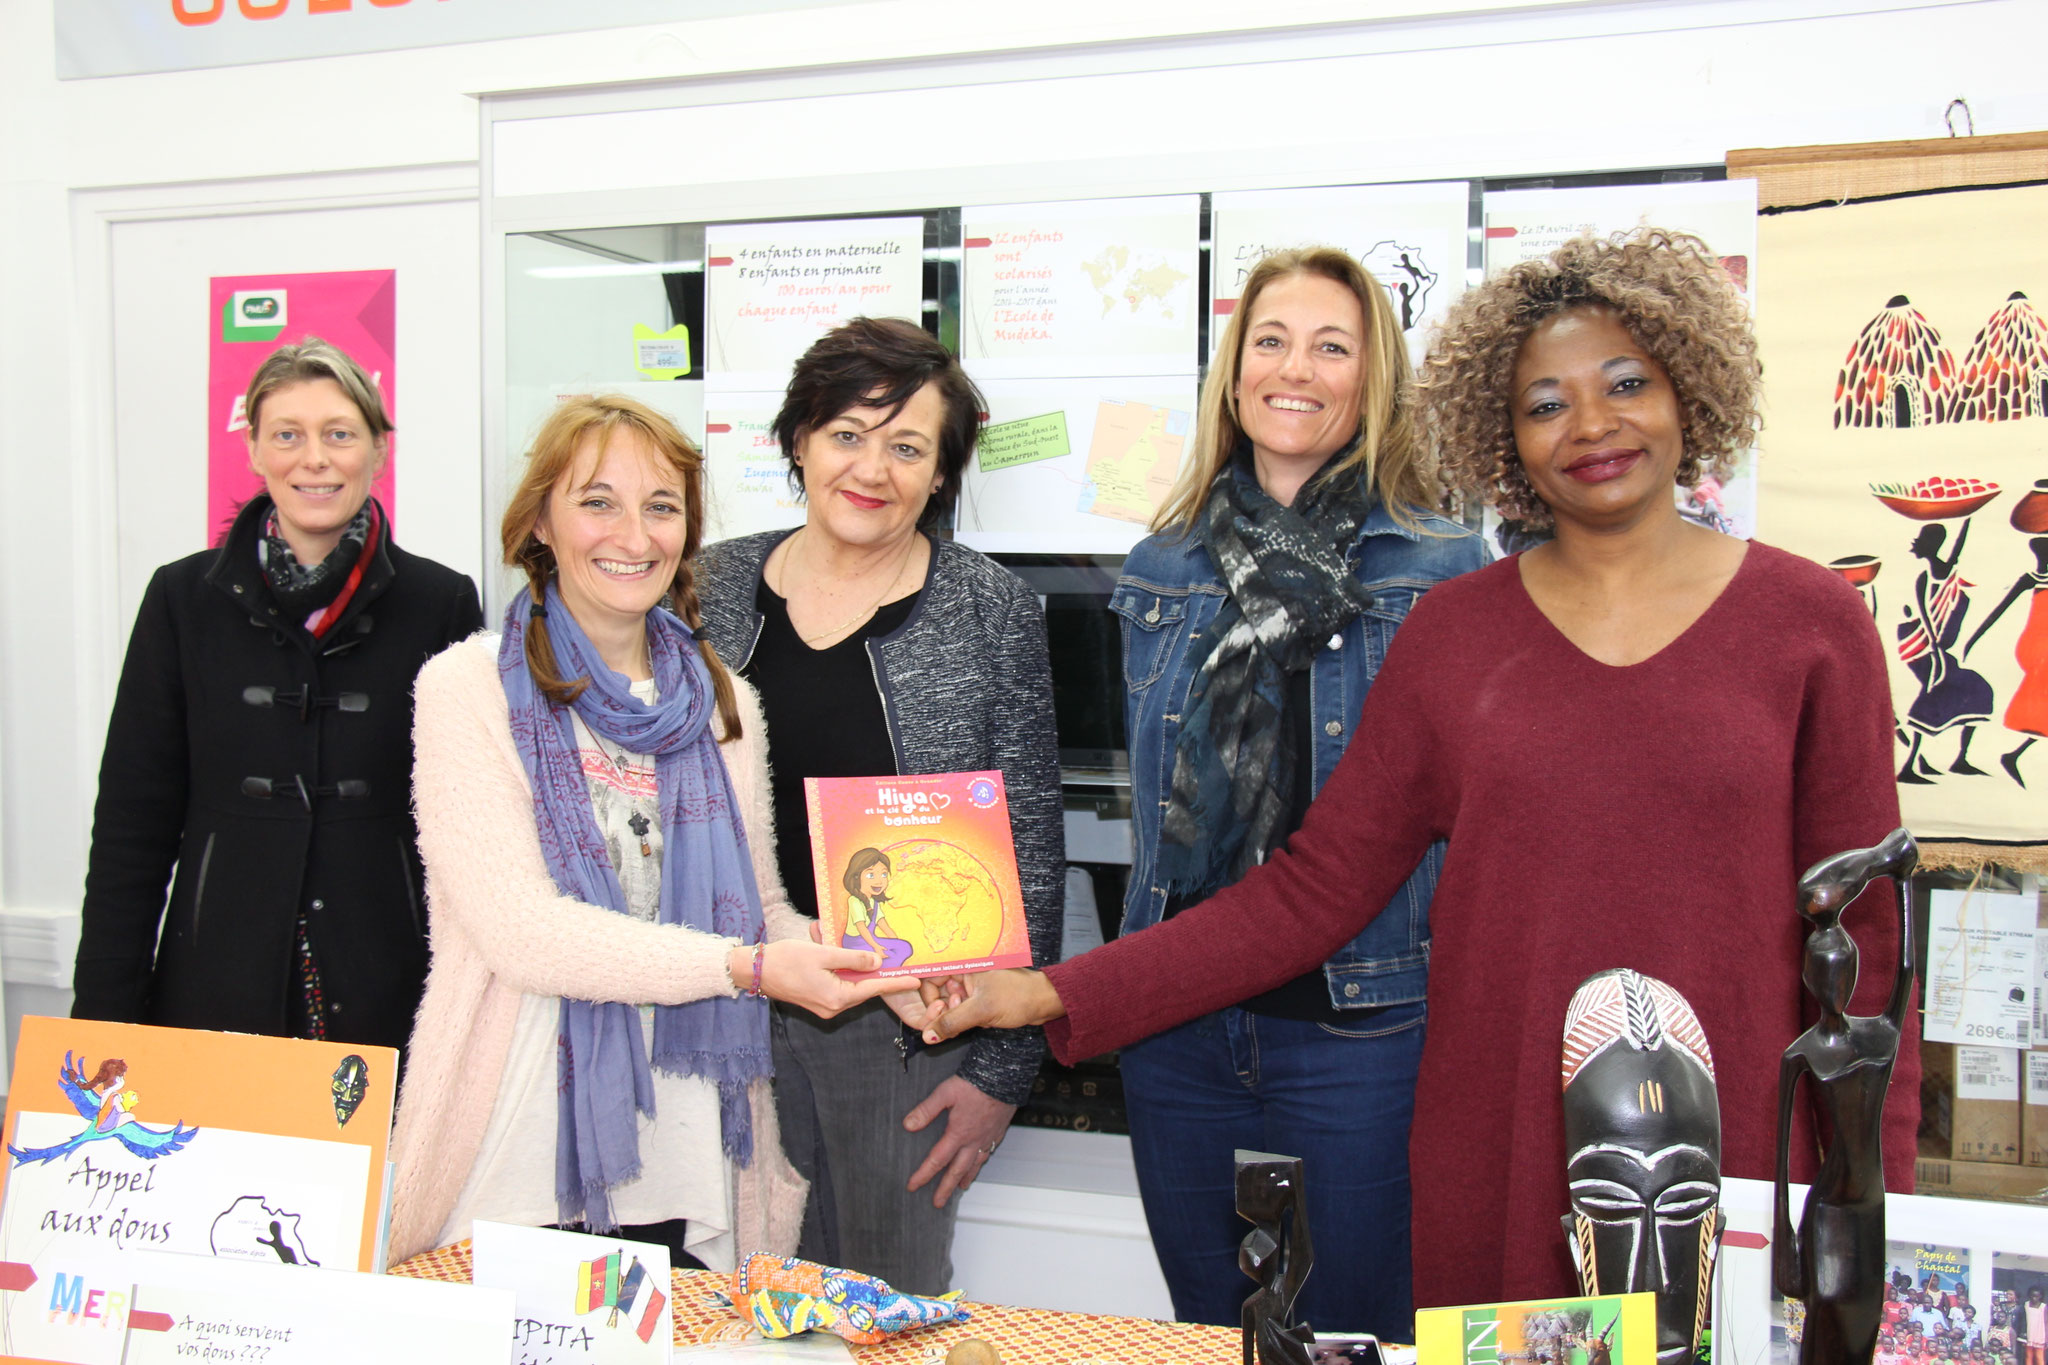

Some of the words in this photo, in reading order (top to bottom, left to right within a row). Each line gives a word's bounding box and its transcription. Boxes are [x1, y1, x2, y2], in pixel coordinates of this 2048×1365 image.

[1012, 229, 1064, 250] enfants
[739, 248, 750, 259] 4
[751, 245, 803, 268] enfants
[806, 248, 822, 258] en
[825, 241, 902, 257] maternelle
[995, 252, 1021, 262] sont
[739, 267, 746, 279] 8
[749, 265, 801, 286] enfants
[804, 268, 820, 278] en
[823, 263, 883, 285] primaire
[994, 266, 1053, 280] scolarisés
[860, 284, 892, 303] pour
[994, 288, 1013, 296] pour
[737, 302, 787, 322] chaque
[789, 301, 839, 323] enfant
[994, 310, 1038, 323] l'Ecole
[1041, 308, 1054, 325] de
[993, 451, 1040, 465] Cameroun
[865, 807, 875, 815] et
[876, 806, 886, 814] la
[887, 804, 900, 814] clé
[918, 805, 931, 813] du
[878, 788, 929, 814] Hiya
[884, 814, 943, 827] bonheur
[68, 1155, 157, 1210] Appel
[40, 1209, 104, 1236] aux
[107, 1207, 174, 1251] dons
[1914, 1248, 1944, 1264] Papy
[1945, 1252, 1957, 1262] de
[1914, 1262, 1961, 1274] Chantal
[178, 1314, 195, 1331] A
[195, 1318, 233, 1341] quoi
[234, 1324, 293, 1343] servent
[176, 1342, 200, 1357] vos
[202, 1341, 236, 1365] dons
